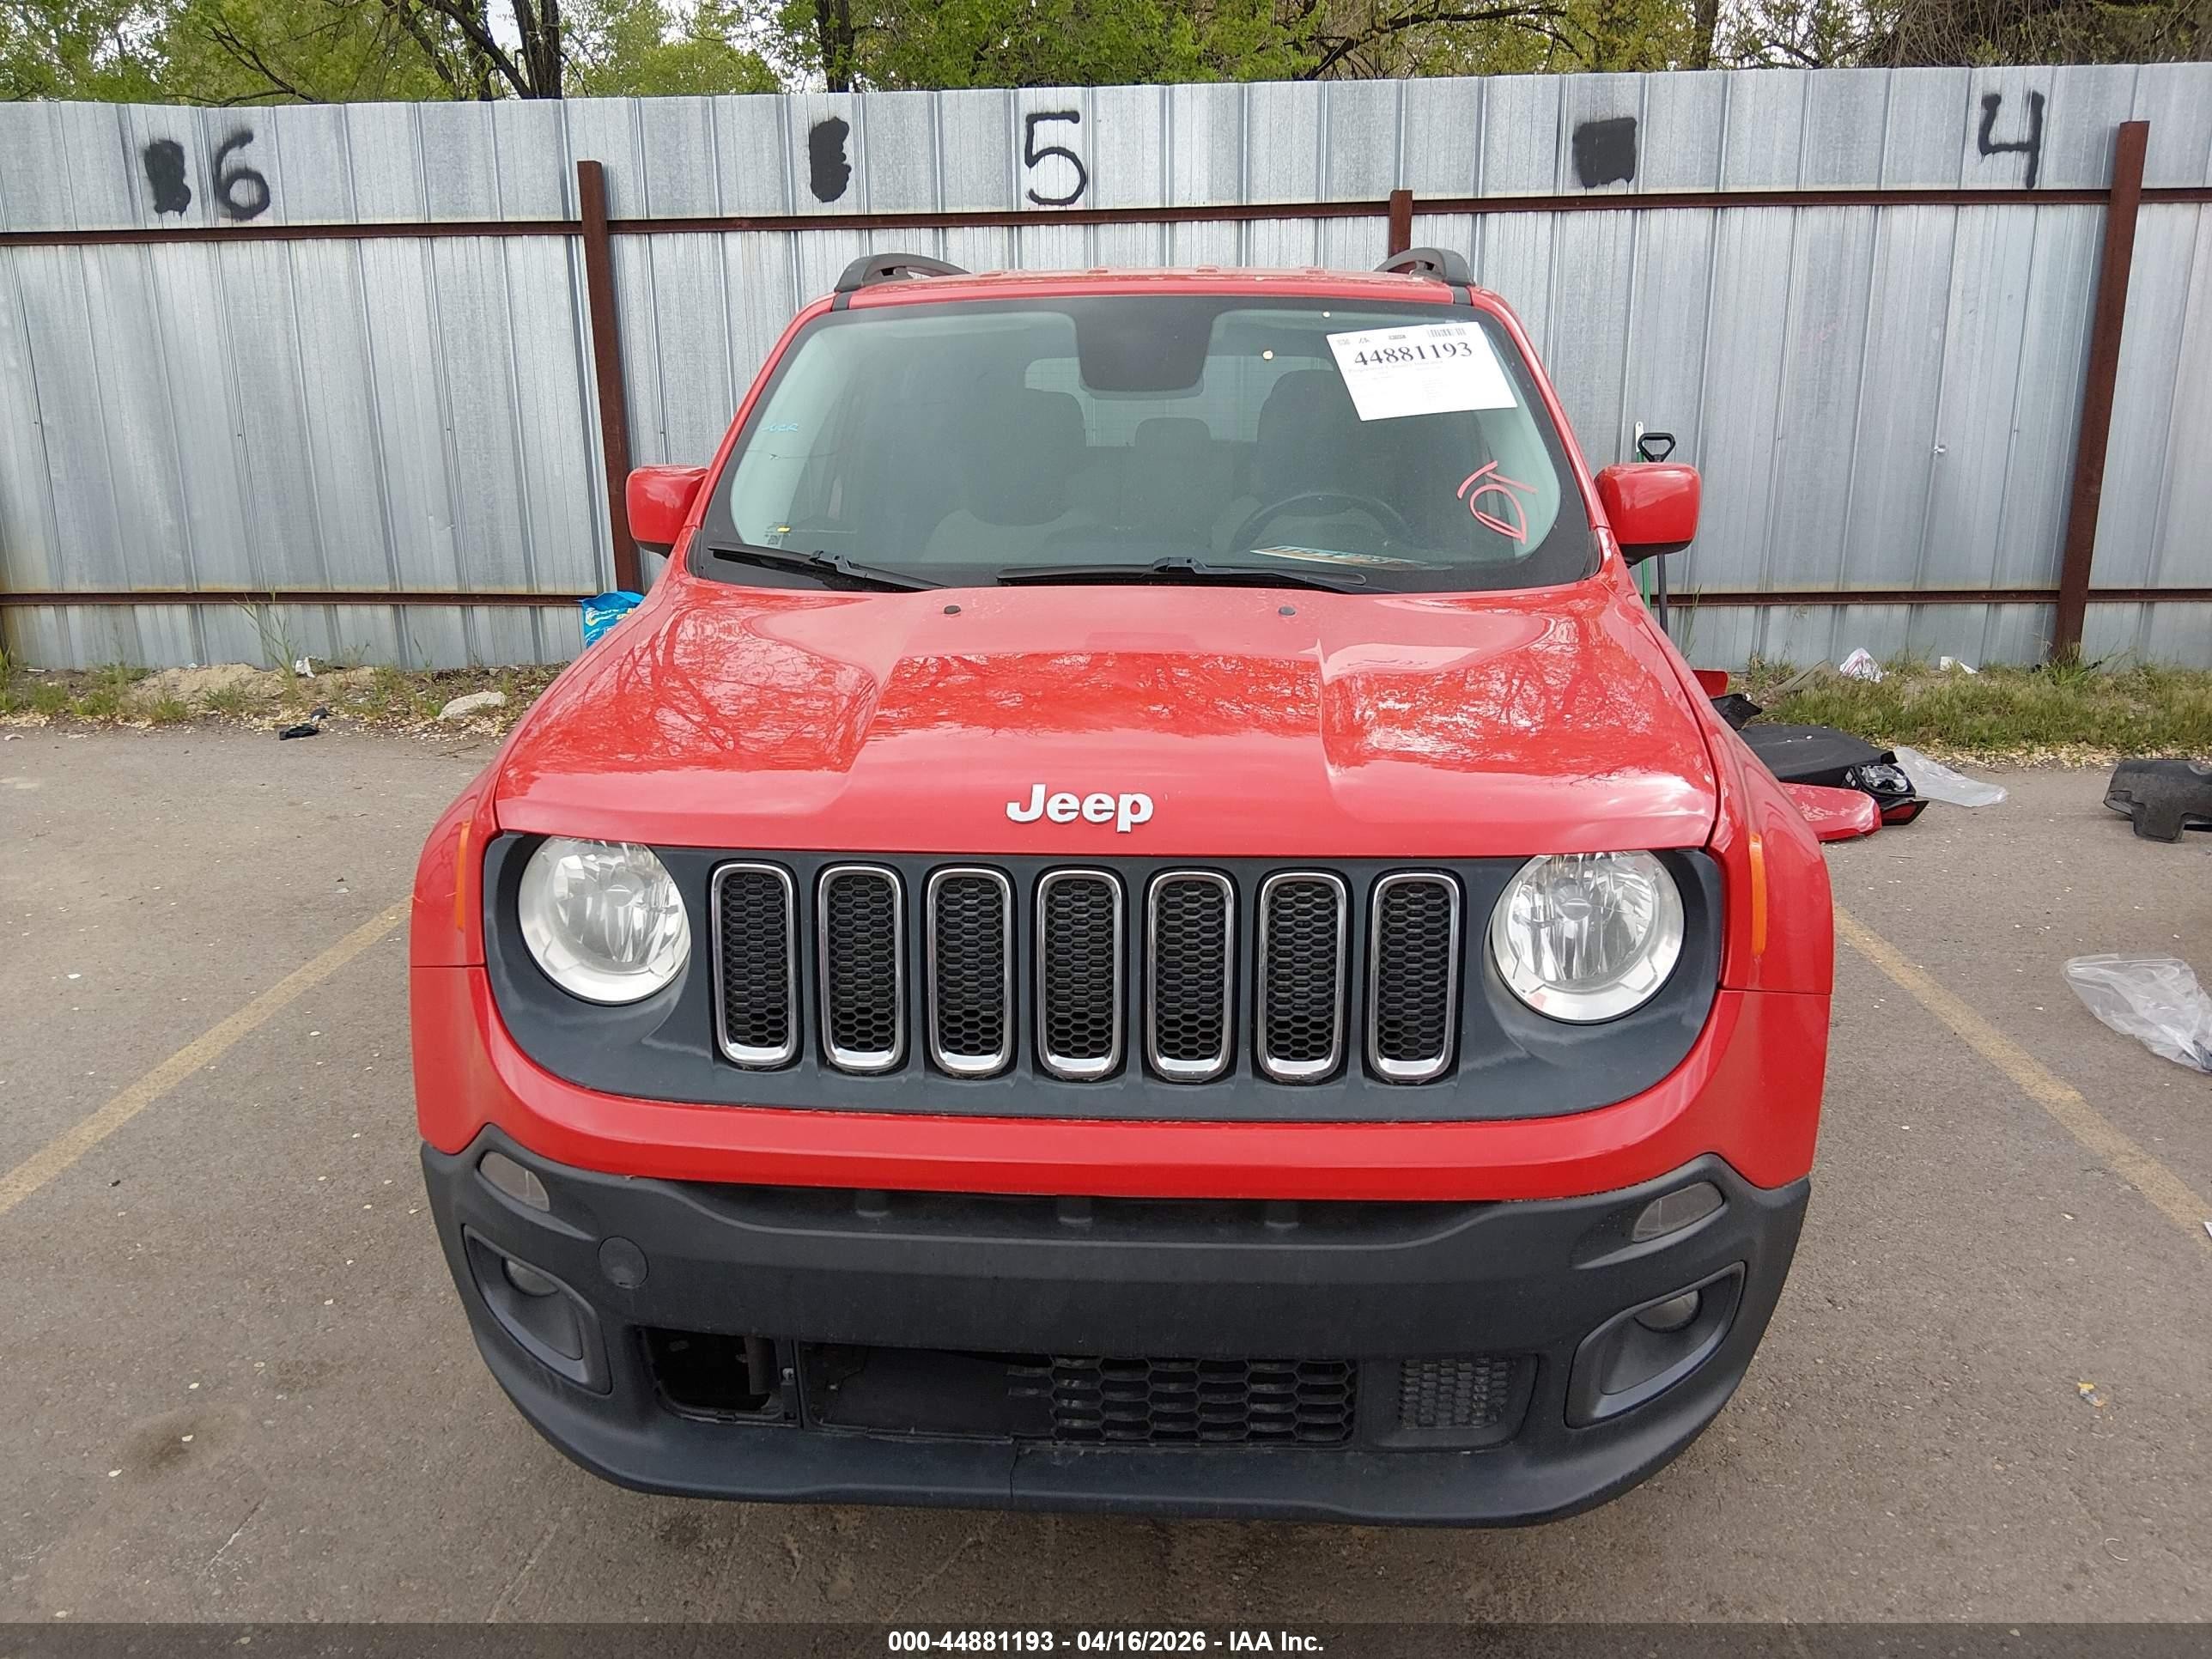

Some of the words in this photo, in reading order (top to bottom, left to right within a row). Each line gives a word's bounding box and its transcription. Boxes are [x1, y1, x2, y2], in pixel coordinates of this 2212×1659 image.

[215, 129, 270, 221] 6
[1024, 110, 1087, 205] 5
[1977, 90, 2045, 190] 4
[1353, 341, 1474, 367] 44881193
[1006, 783, 1154, 834] Jeep
